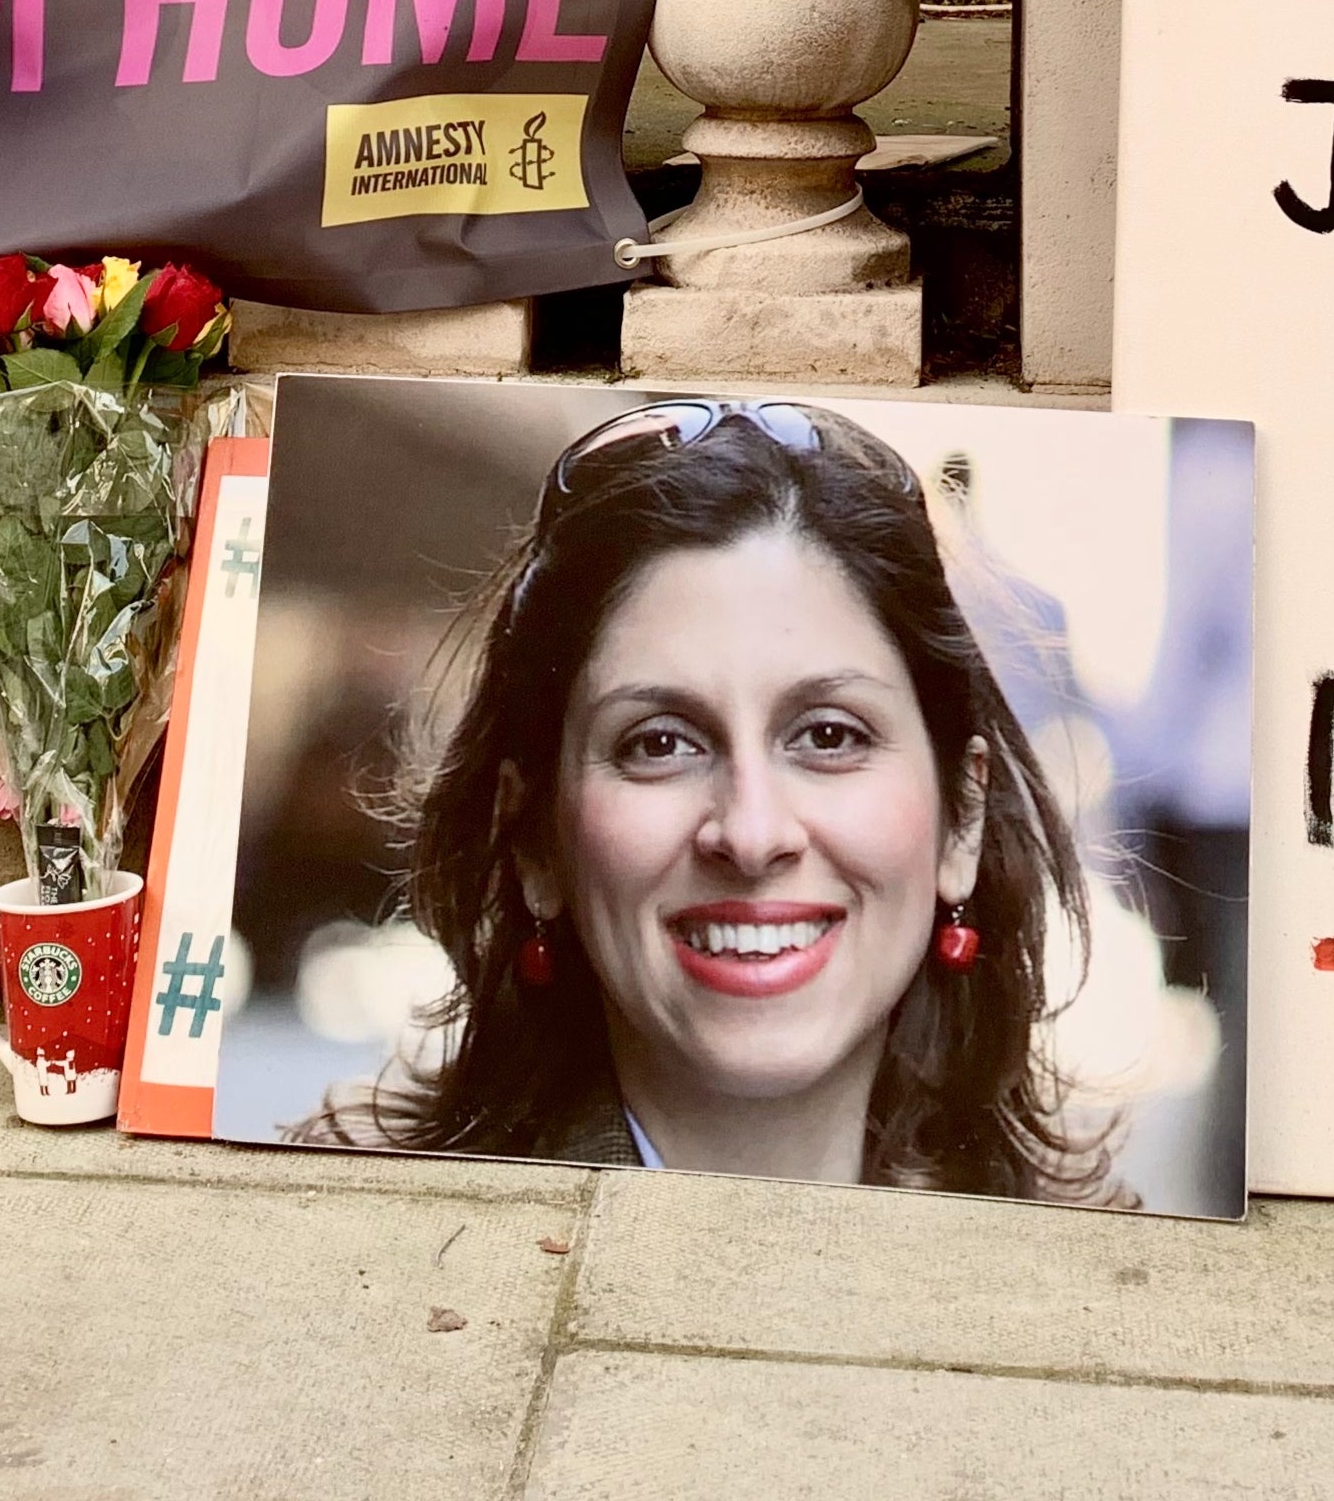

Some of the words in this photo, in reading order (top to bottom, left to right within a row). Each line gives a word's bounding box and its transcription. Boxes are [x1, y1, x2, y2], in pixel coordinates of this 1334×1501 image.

[354, 119, 486, 169] AMNESTY
[350, 162, 488, 196] INTERNATIONAL
[21, 945, 77, 971] STARBUCKS
[28, 987, 72, 1003] COFFEE
